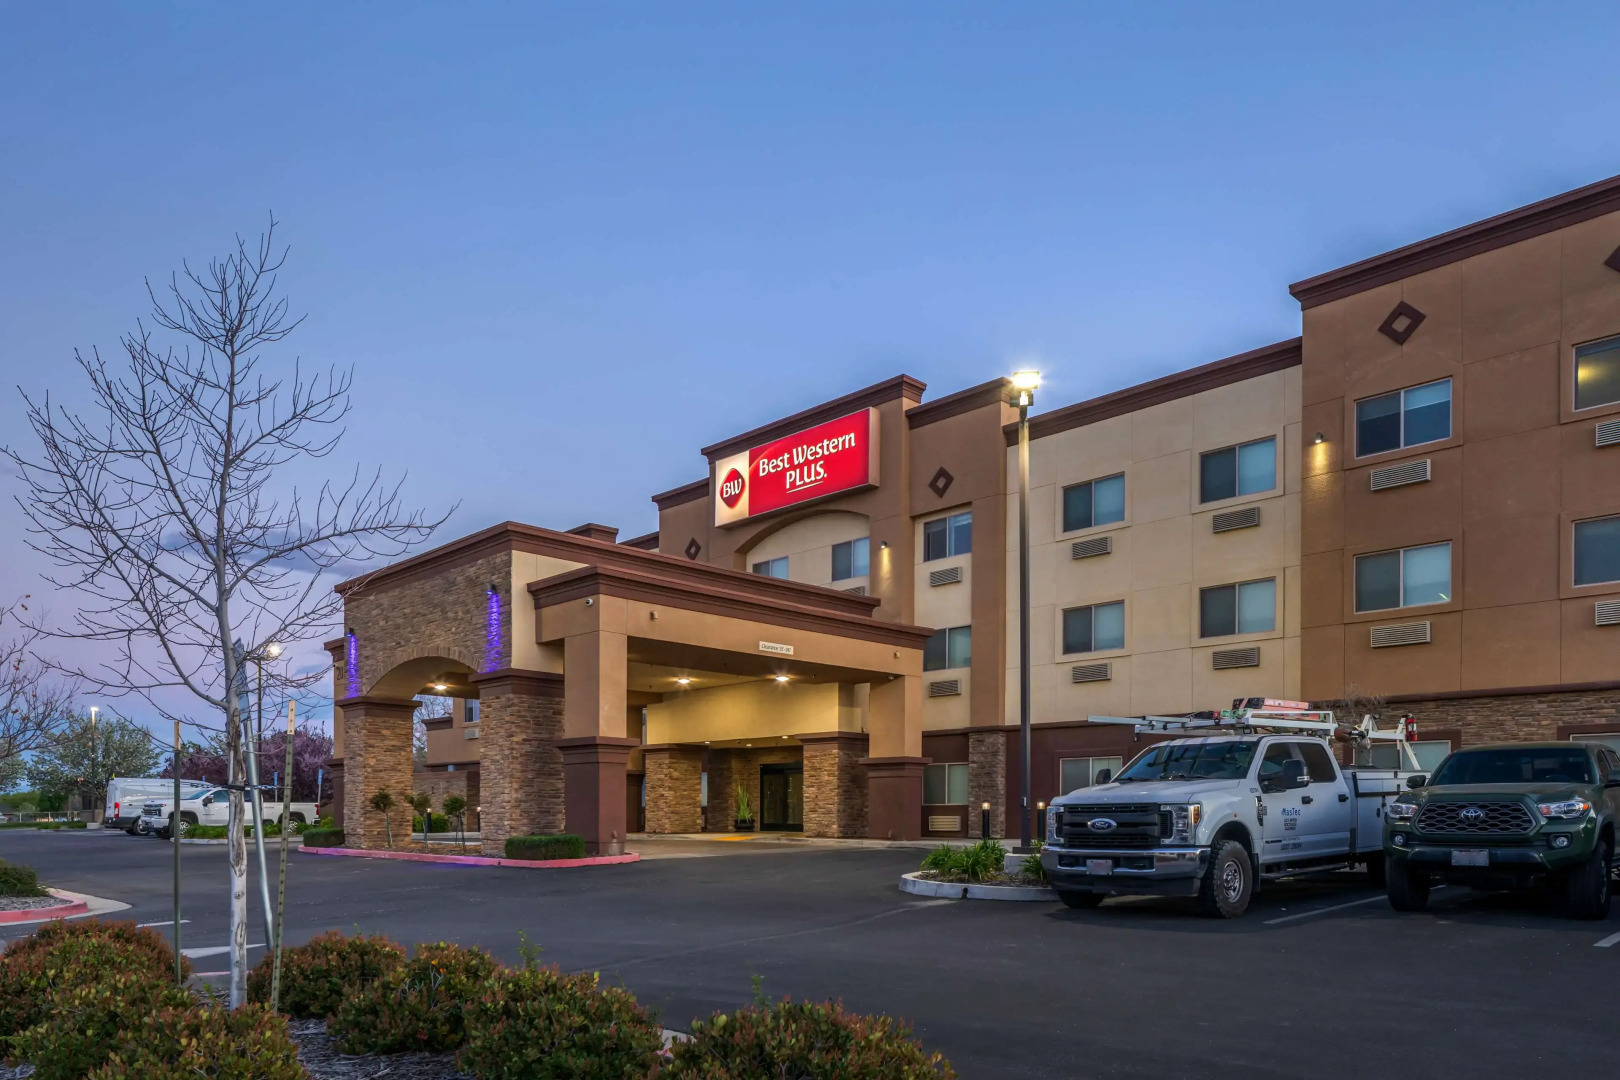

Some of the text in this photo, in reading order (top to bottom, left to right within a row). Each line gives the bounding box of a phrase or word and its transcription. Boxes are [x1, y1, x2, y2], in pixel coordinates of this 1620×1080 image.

[759, 432, 856, 477] Best Western
[722, 478, 742, 498] BW
